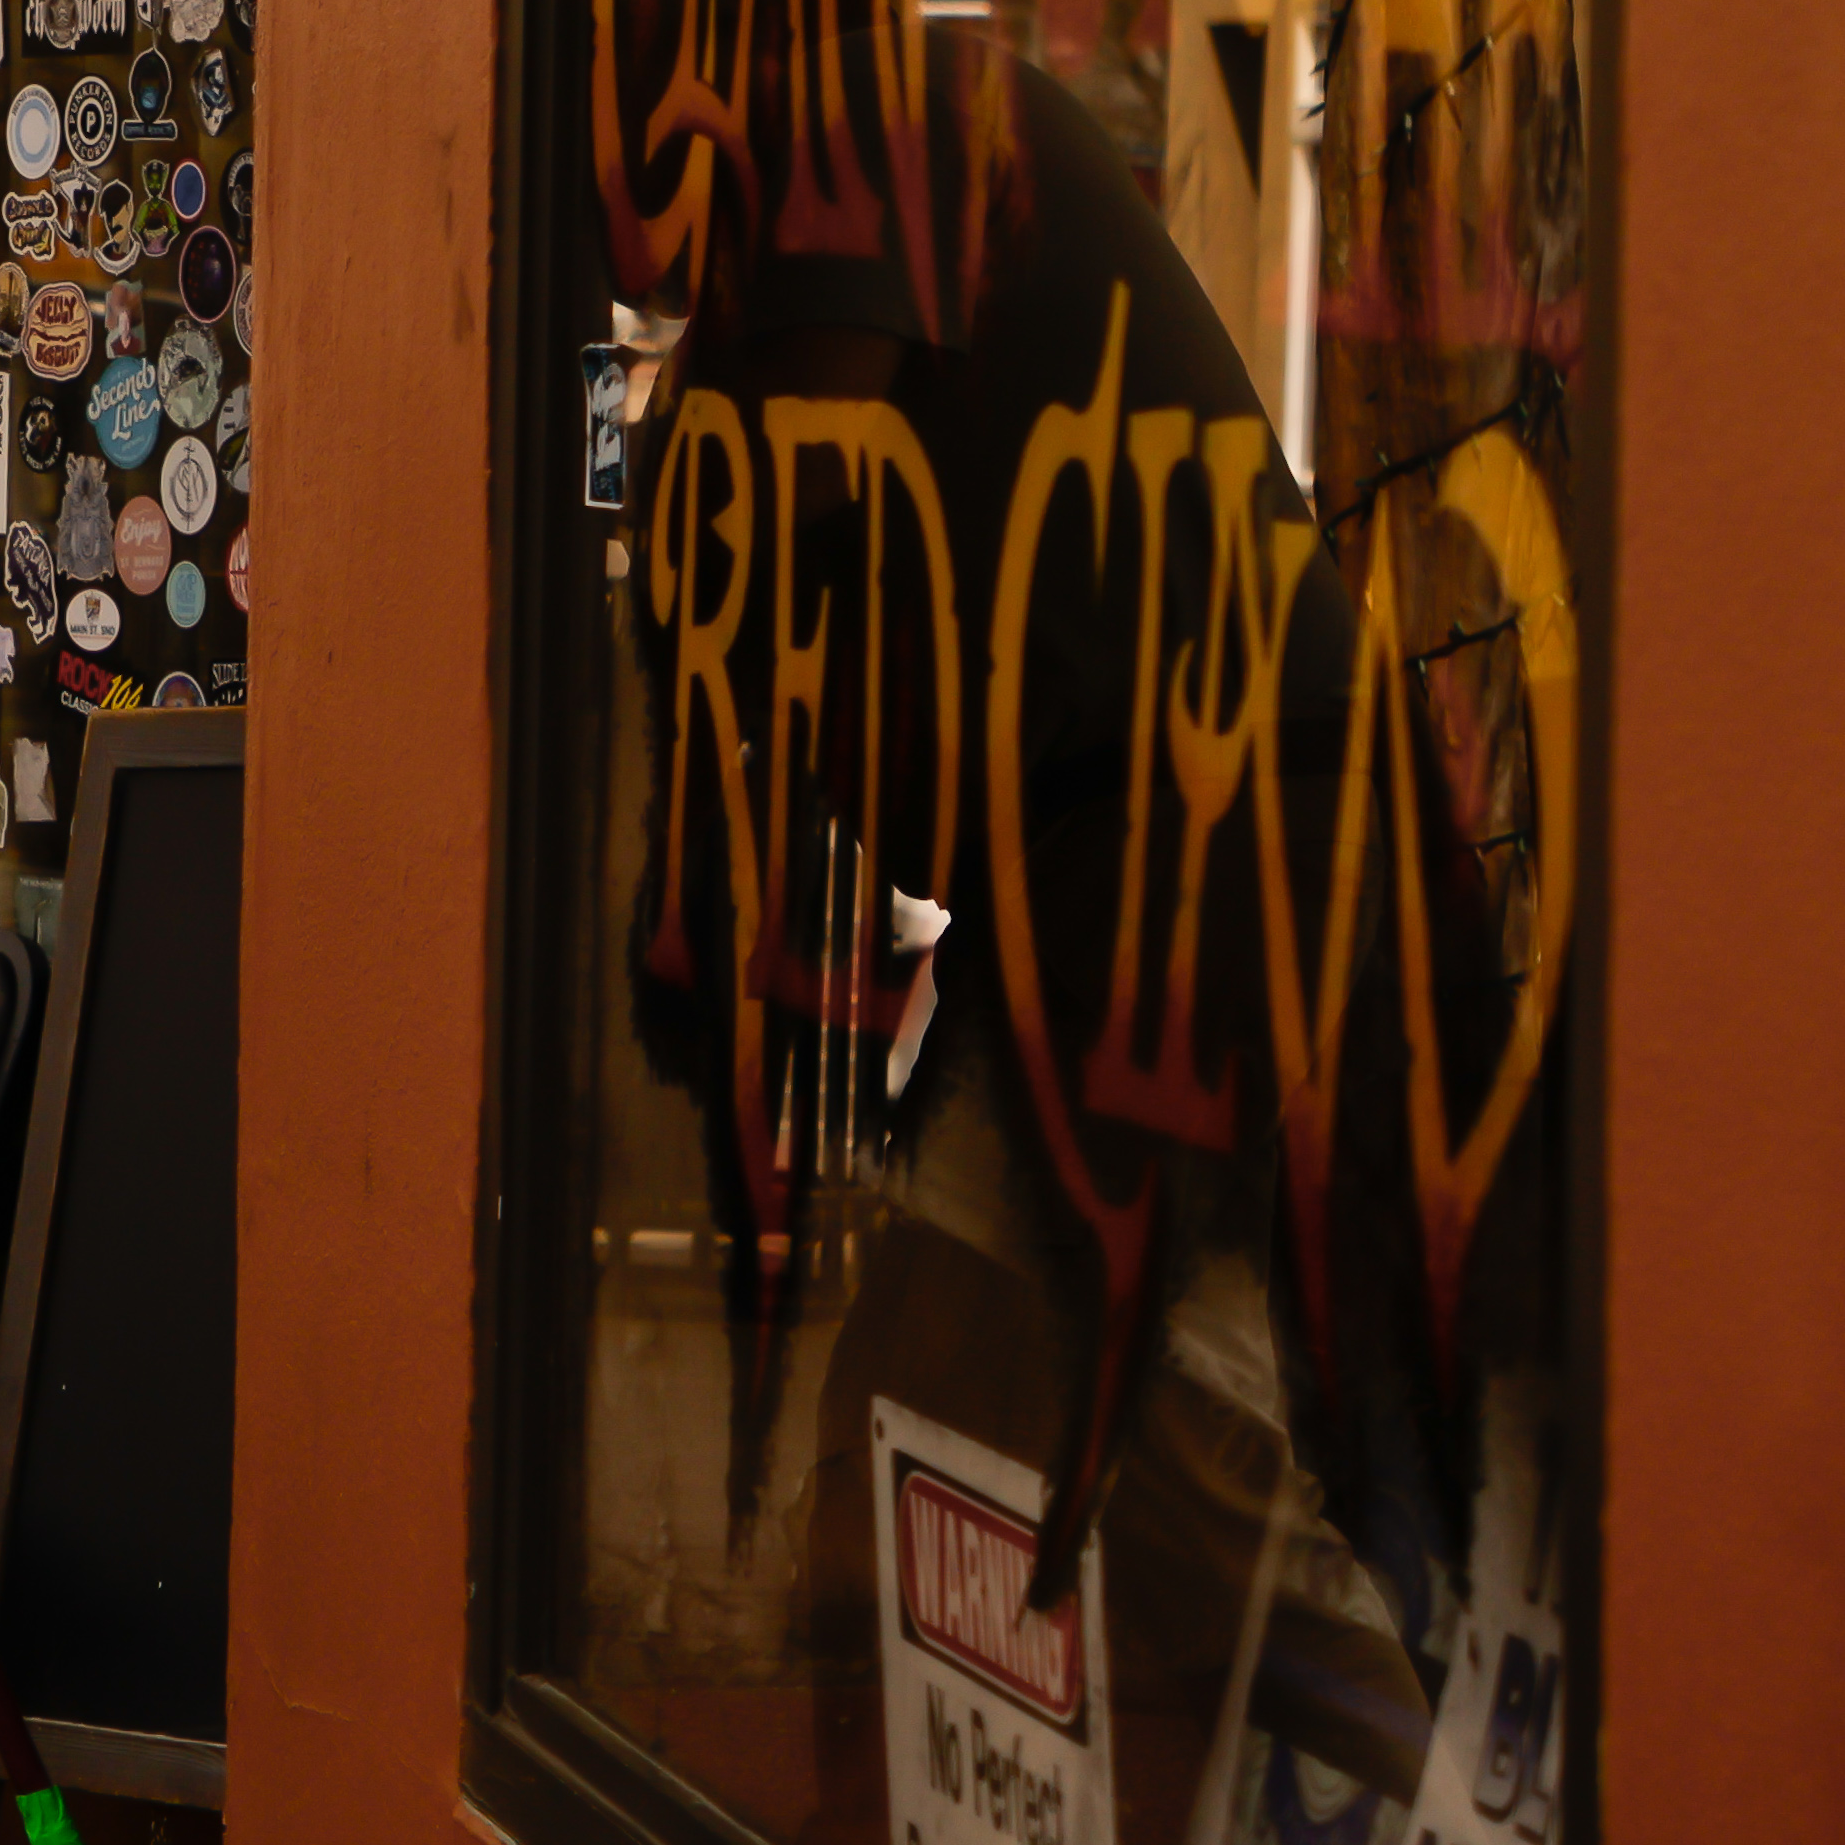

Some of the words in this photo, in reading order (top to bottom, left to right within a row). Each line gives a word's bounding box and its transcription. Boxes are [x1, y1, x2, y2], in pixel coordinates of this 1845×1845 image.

[87, 357, 156, 421] Second
[112, 399, 161, 440] Line
[120, 518, 161, 546] Enjoy
[58, 651, 111, 702] ROCK
[925, 1681, 963, 1806] No
